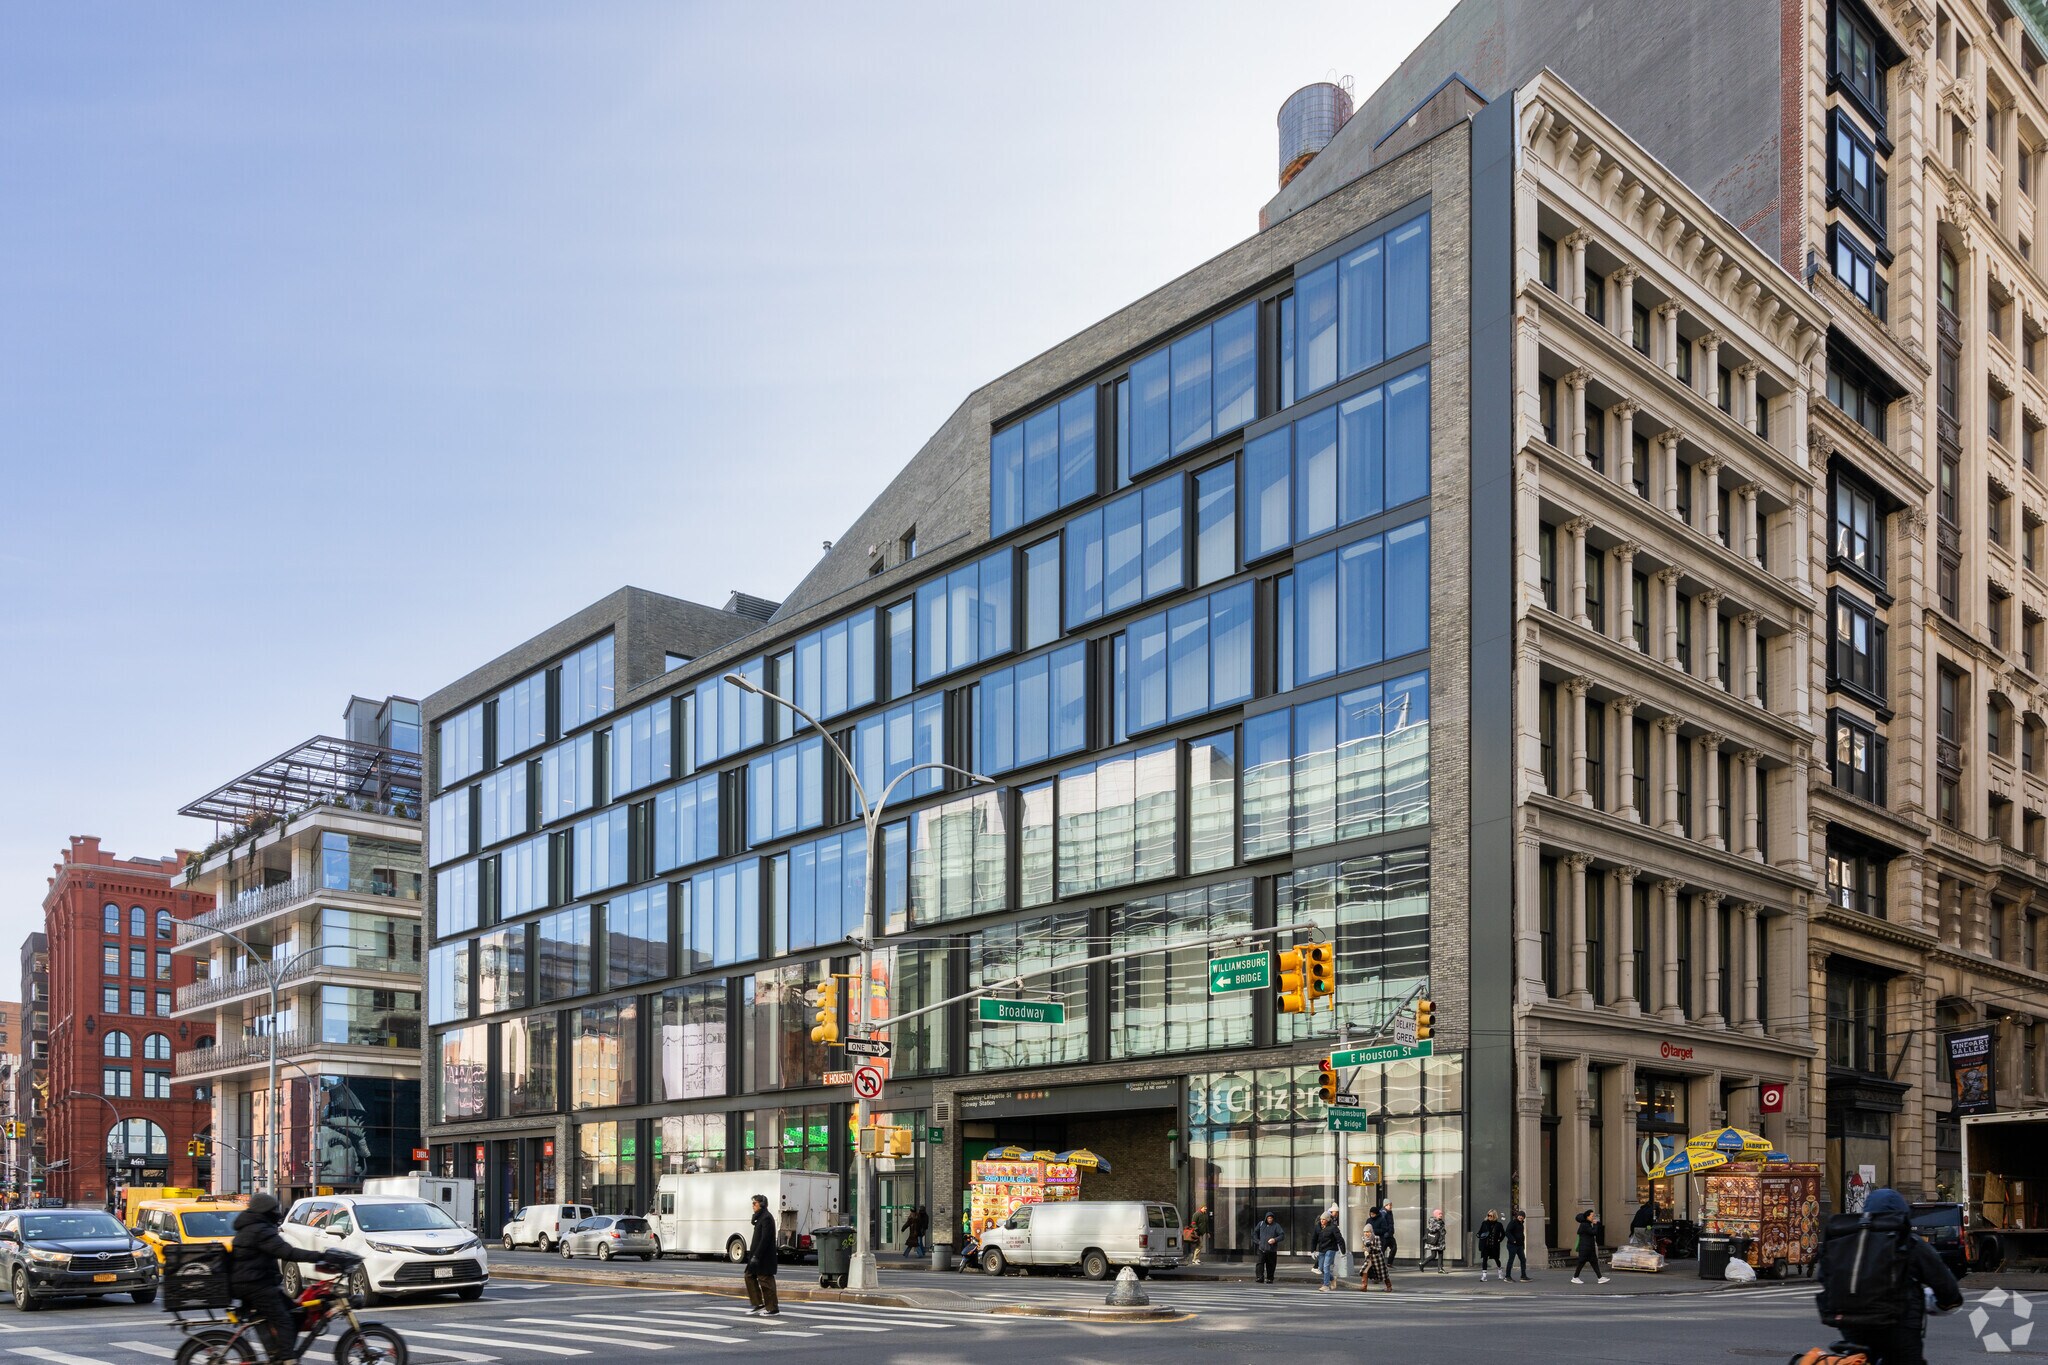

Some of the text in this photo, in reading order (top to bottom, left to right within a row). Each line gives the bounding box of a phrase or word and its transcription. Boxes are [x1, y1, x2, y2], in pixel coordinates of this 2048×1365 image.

[1212, 957, 1266, 973] WILLIAMSBURG
[1235, 972, 1262, 984] BRIDGE
[999, 1005, 1044, 1021] Broadway
[1396, 1019, 1416, 1031] DELAYE
[1396, 1032, 1417, 1044] GREEN
[851, 1043, 886, 1053] ONE WAY
[1670, 1045, 1693, 1060] target
[1952, 1044, 1989, 1055] GALLERY
[1350, 1046, 1412, 1063] E Houston St
[823, 1074, 828, 1084] E
[1330, 1110, 1365, 1119] Williamsburg
[1344, 1121, 1362, 1129] Bridge
[416, 1150, 429, 1159] JBL
[1693, 1157, 1725, 1169] SABRETT
[984, 1175, 1031, 1183] SOHO HALAL GUYS
